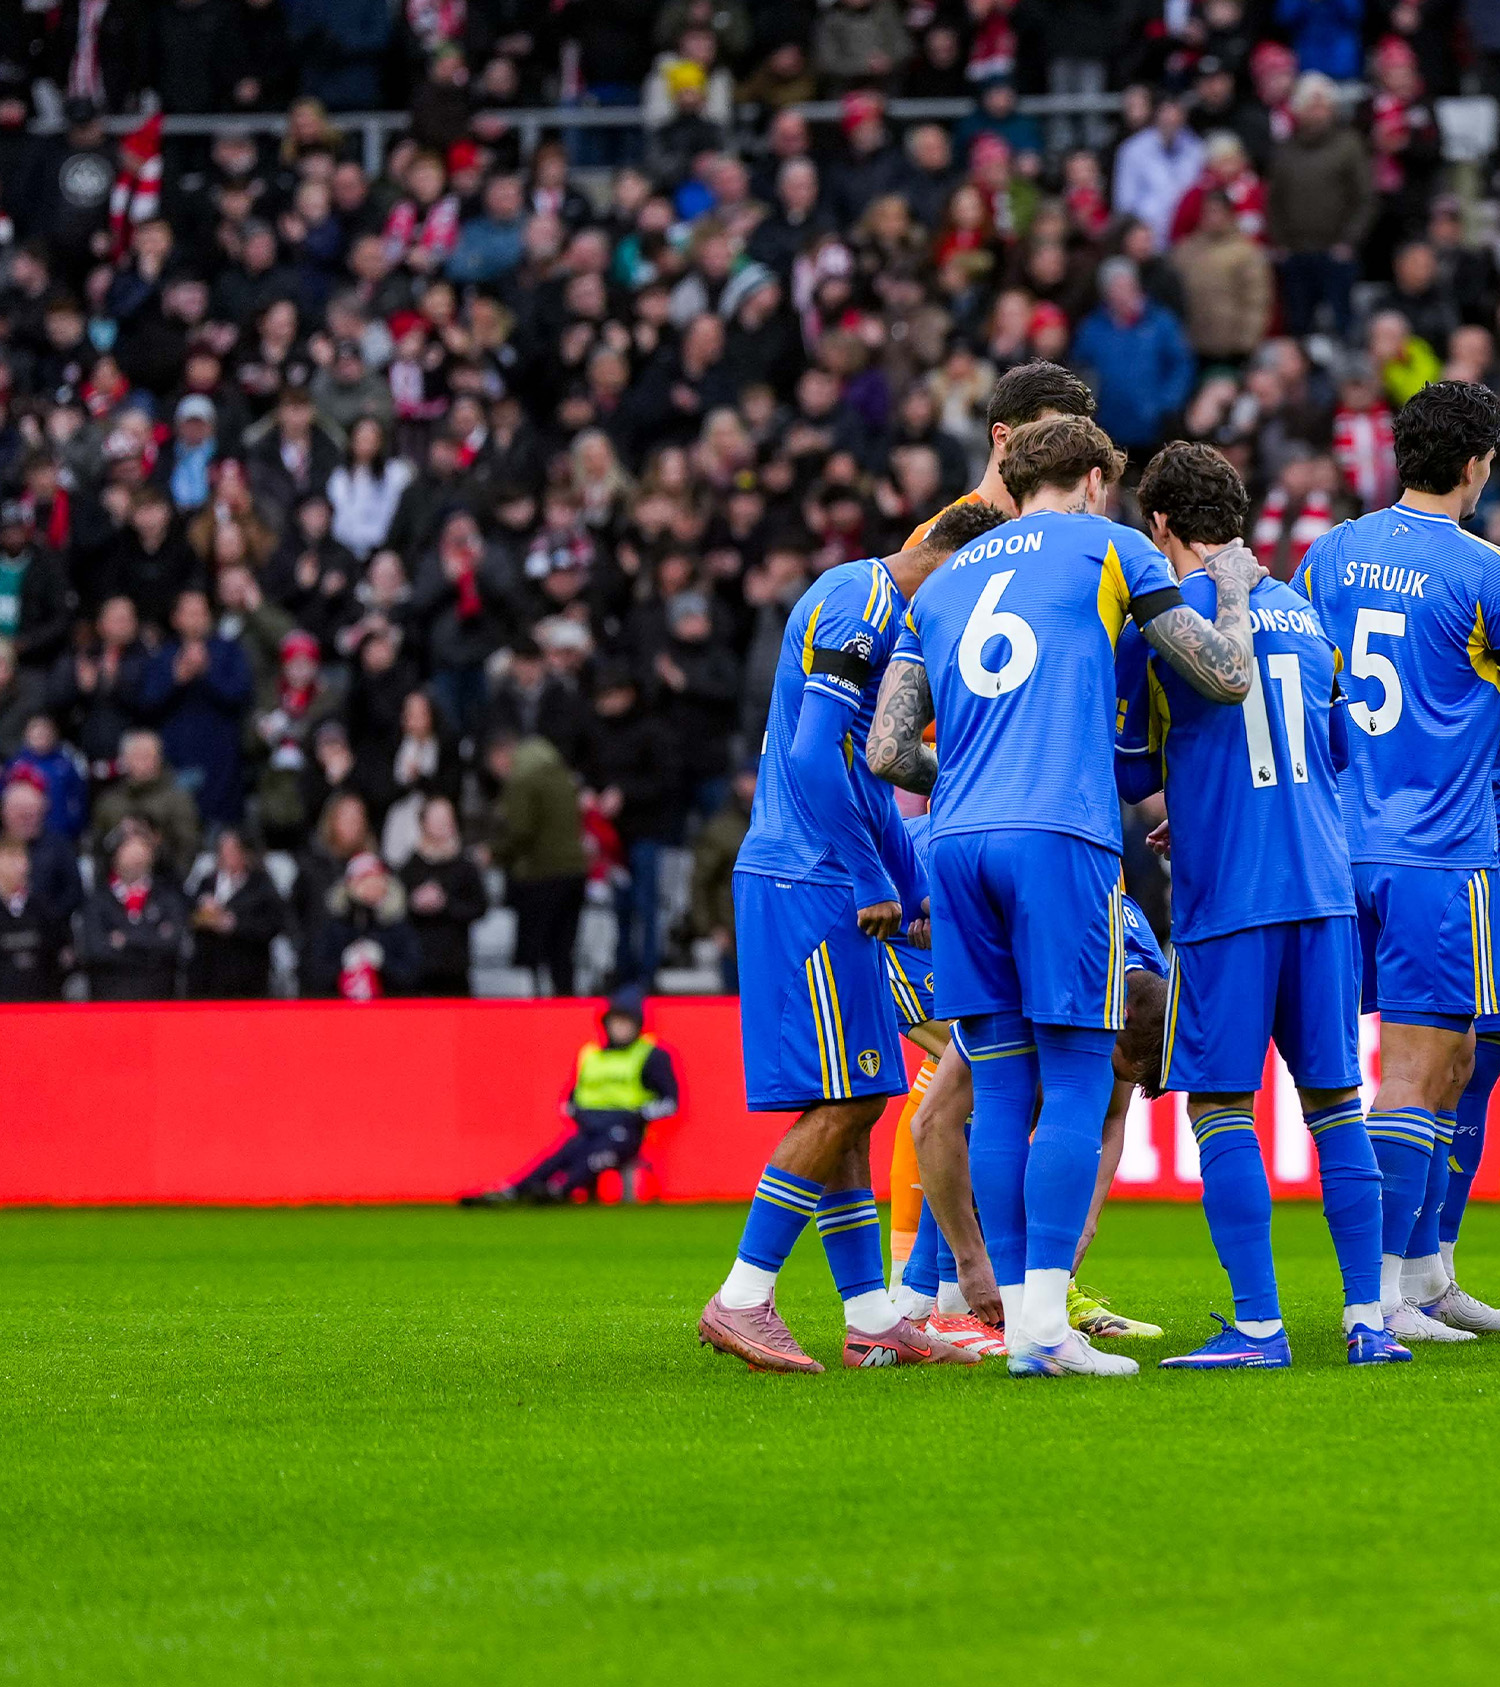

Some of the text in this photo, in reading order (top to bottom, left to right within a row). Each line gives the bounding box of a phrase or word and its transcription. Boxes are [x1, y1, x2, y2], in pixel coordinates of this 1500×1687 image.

[952, 531, 1043, 571] RODON
[1343, 561, 1430, 598] STRUIJK
[958, 568, 1038, 698] 6
[1249, 607, 1318, 636] ONSON
[1347, 607, 1406, 736] 5
[1242, 653, 1309, 789] 11
[1456, 1125, 1479, 1136] FC
